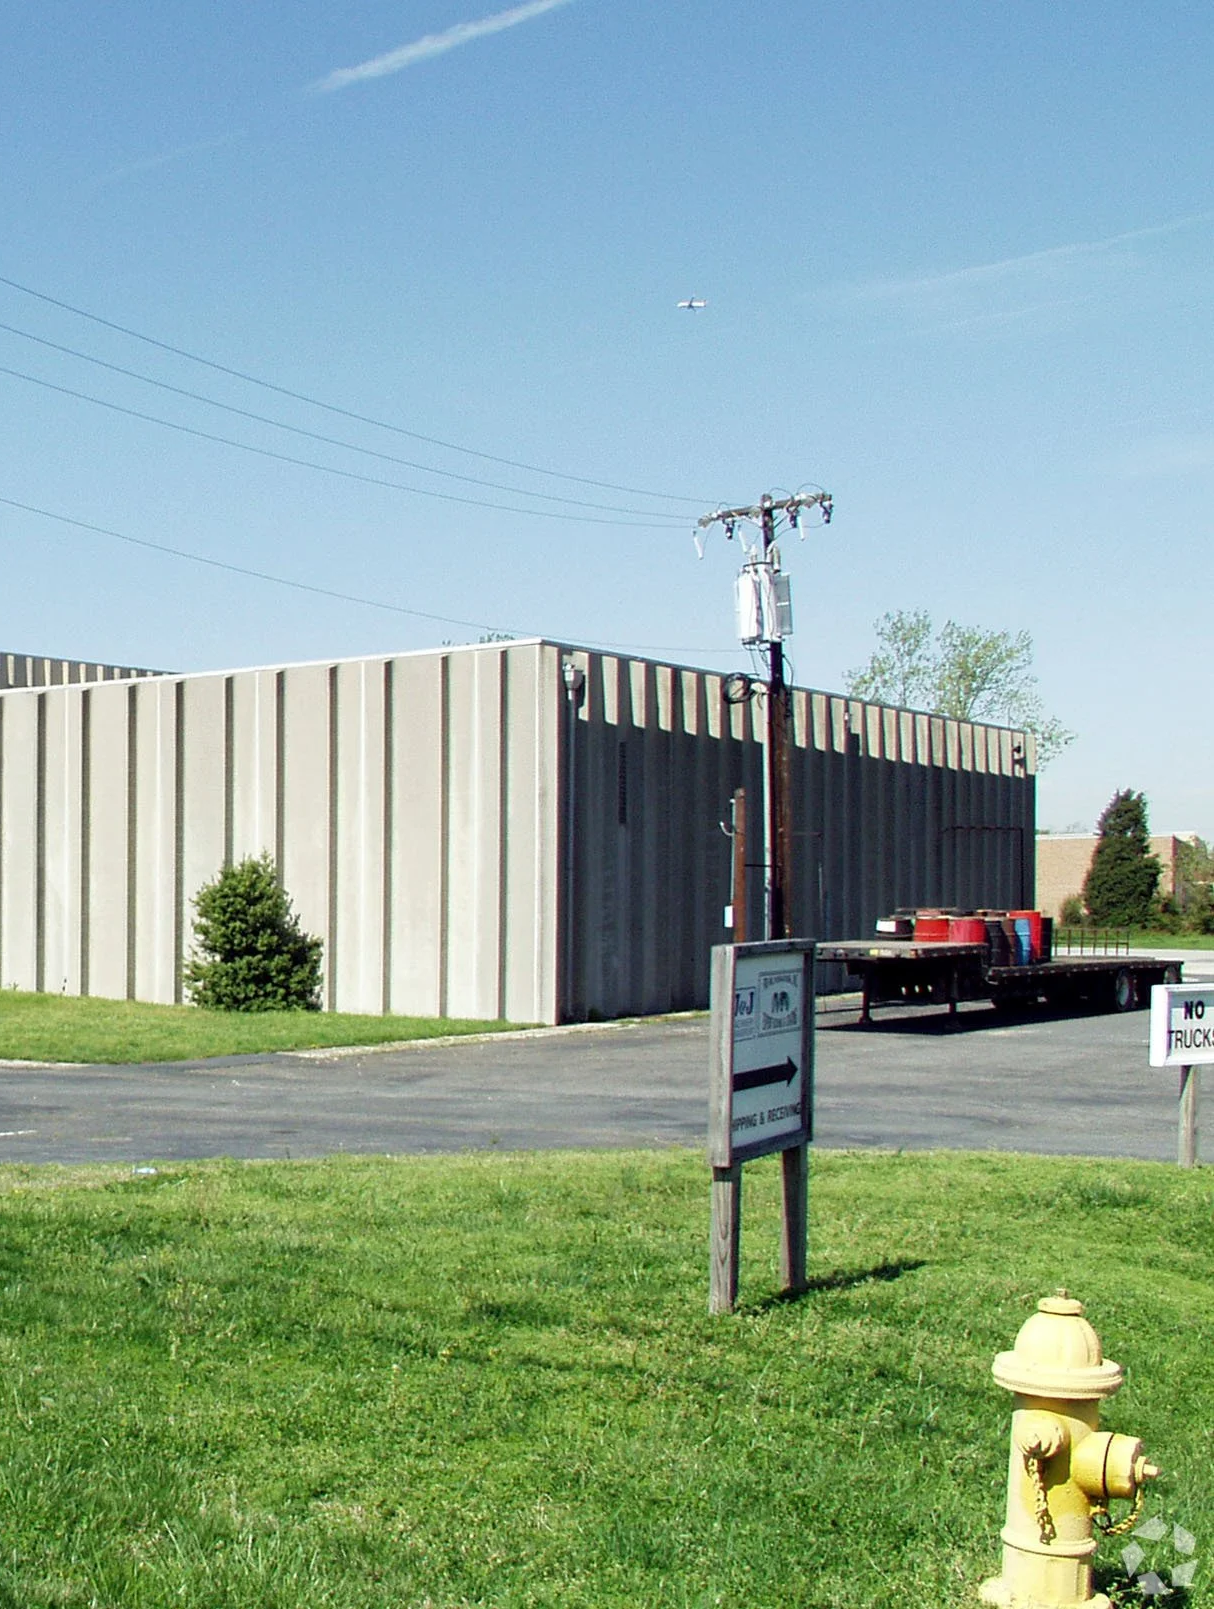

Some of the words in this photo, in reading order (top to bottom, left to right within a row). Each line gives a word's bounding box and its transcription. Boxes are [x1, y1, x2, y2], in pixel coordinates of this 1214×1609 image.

[1183, 1000, 1205, 1020] NO
[759, 1111, 765, 1125] &
[768, 1102, 802, 1123] RECEIVING
